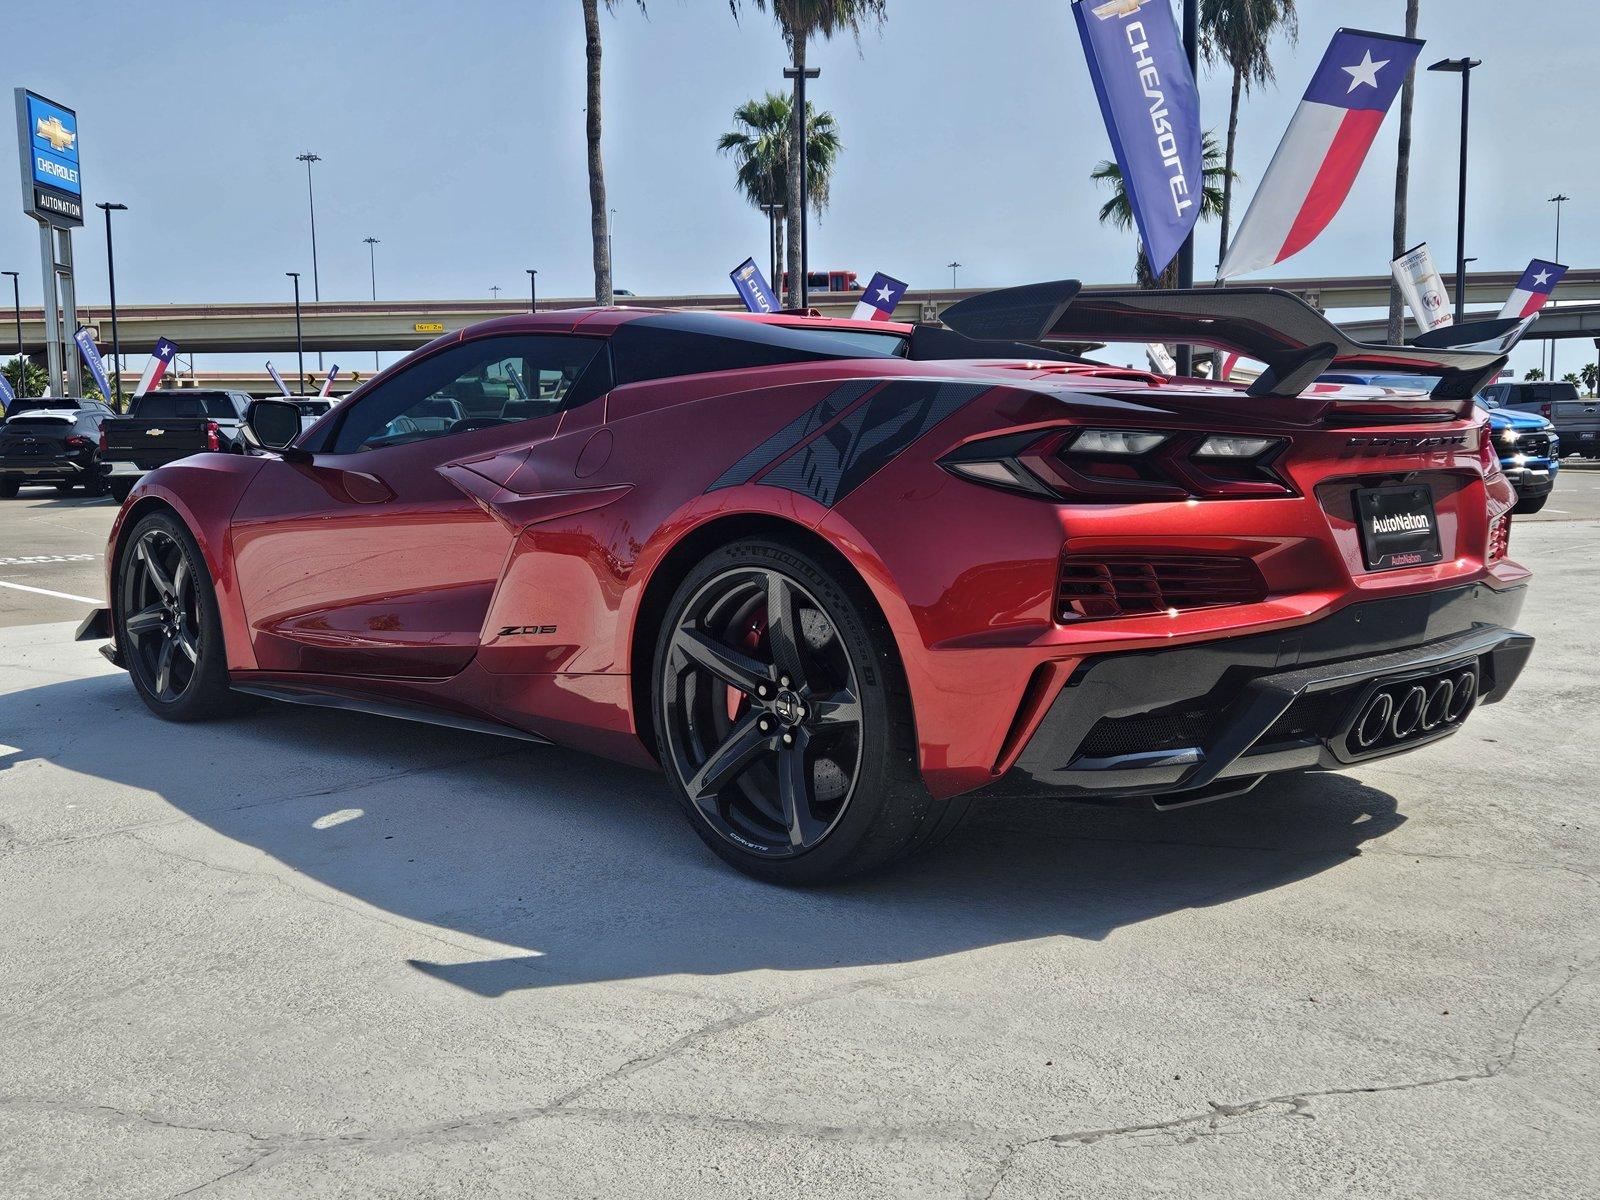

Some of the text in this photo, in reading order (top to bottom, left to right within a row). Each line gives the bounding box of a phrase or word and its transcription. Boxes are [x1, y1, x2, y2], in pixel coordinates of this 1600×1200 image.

[37, 157, 78, 184] CHEVROLET
[40, 194, 80, 217] AUTONATION
[1373, 512, 1429, 534] AutoNation
[1391, 553, 1422, 566] AutoNation
[497, 624, 558, 636] Z06
[729, 832, 769, 851] CORVETTE
